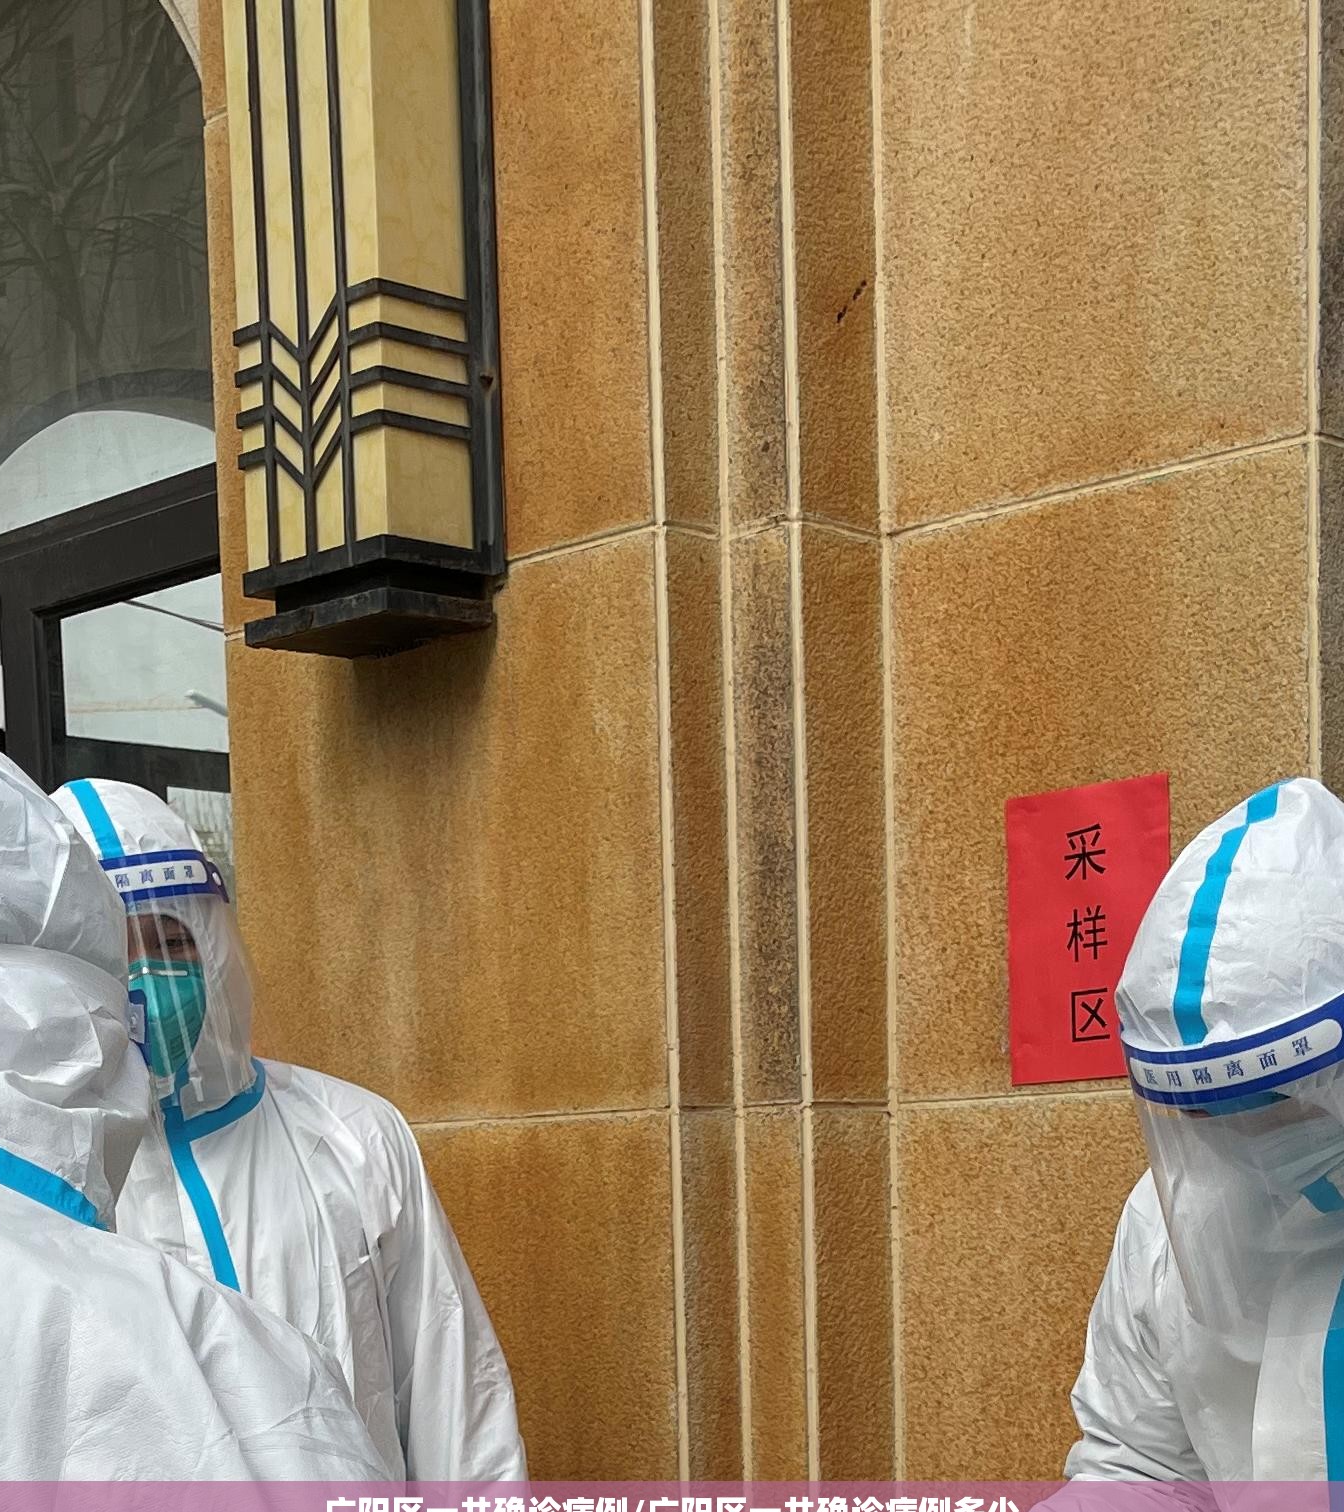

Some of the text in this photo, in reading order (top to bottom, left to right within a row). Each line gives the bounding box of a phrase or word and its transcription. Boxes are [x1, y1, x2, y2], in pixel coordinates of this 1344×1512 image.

[1063, 823, 1111, 1043] 采样区
[1143, 1036, 1313, 1088] 医用隔离面罩
